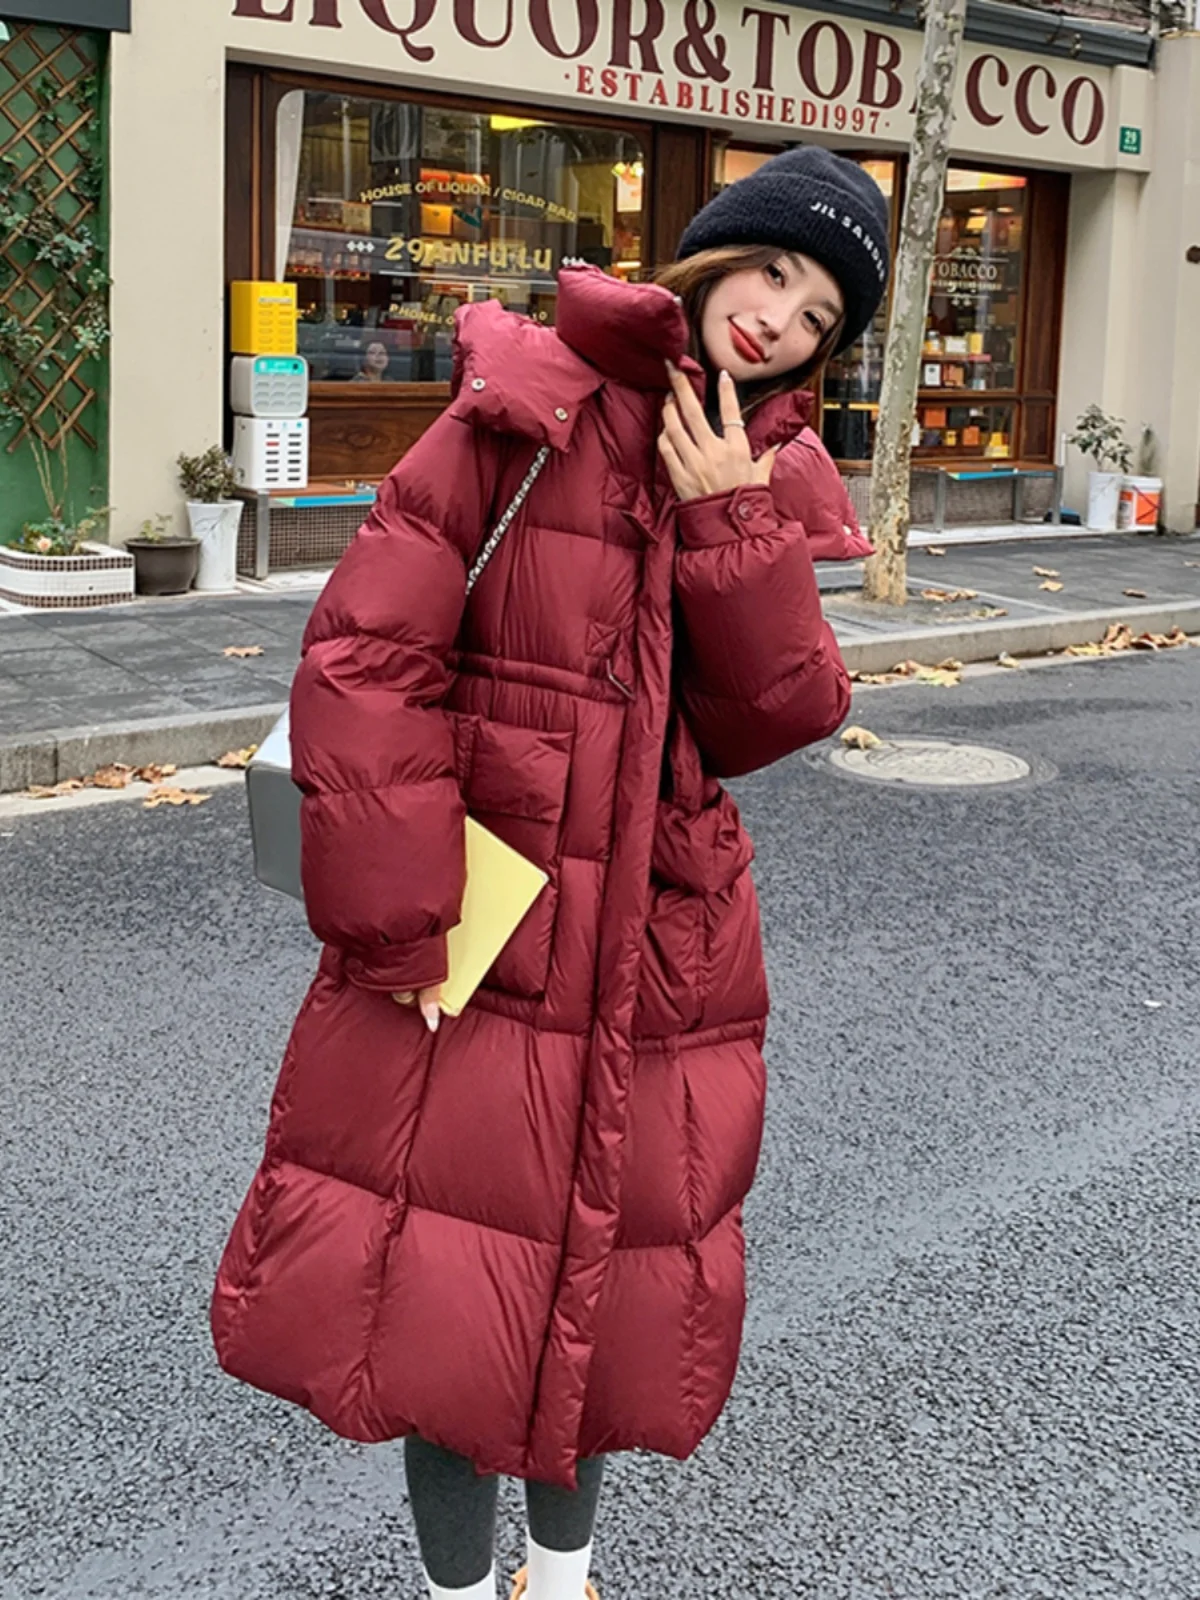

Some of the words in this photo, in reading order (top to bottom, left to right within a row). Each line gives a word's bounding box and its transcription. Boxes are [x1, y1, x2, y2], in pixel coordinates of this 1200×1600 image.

[360, 183, 412, 202] HOUSE
[415, 181, 437, 193] OF
[438, 181, 491, 196] LIQUOR
[502, 188, 545, 208] CIGAR
[810, 202, 836, 219] JIL
